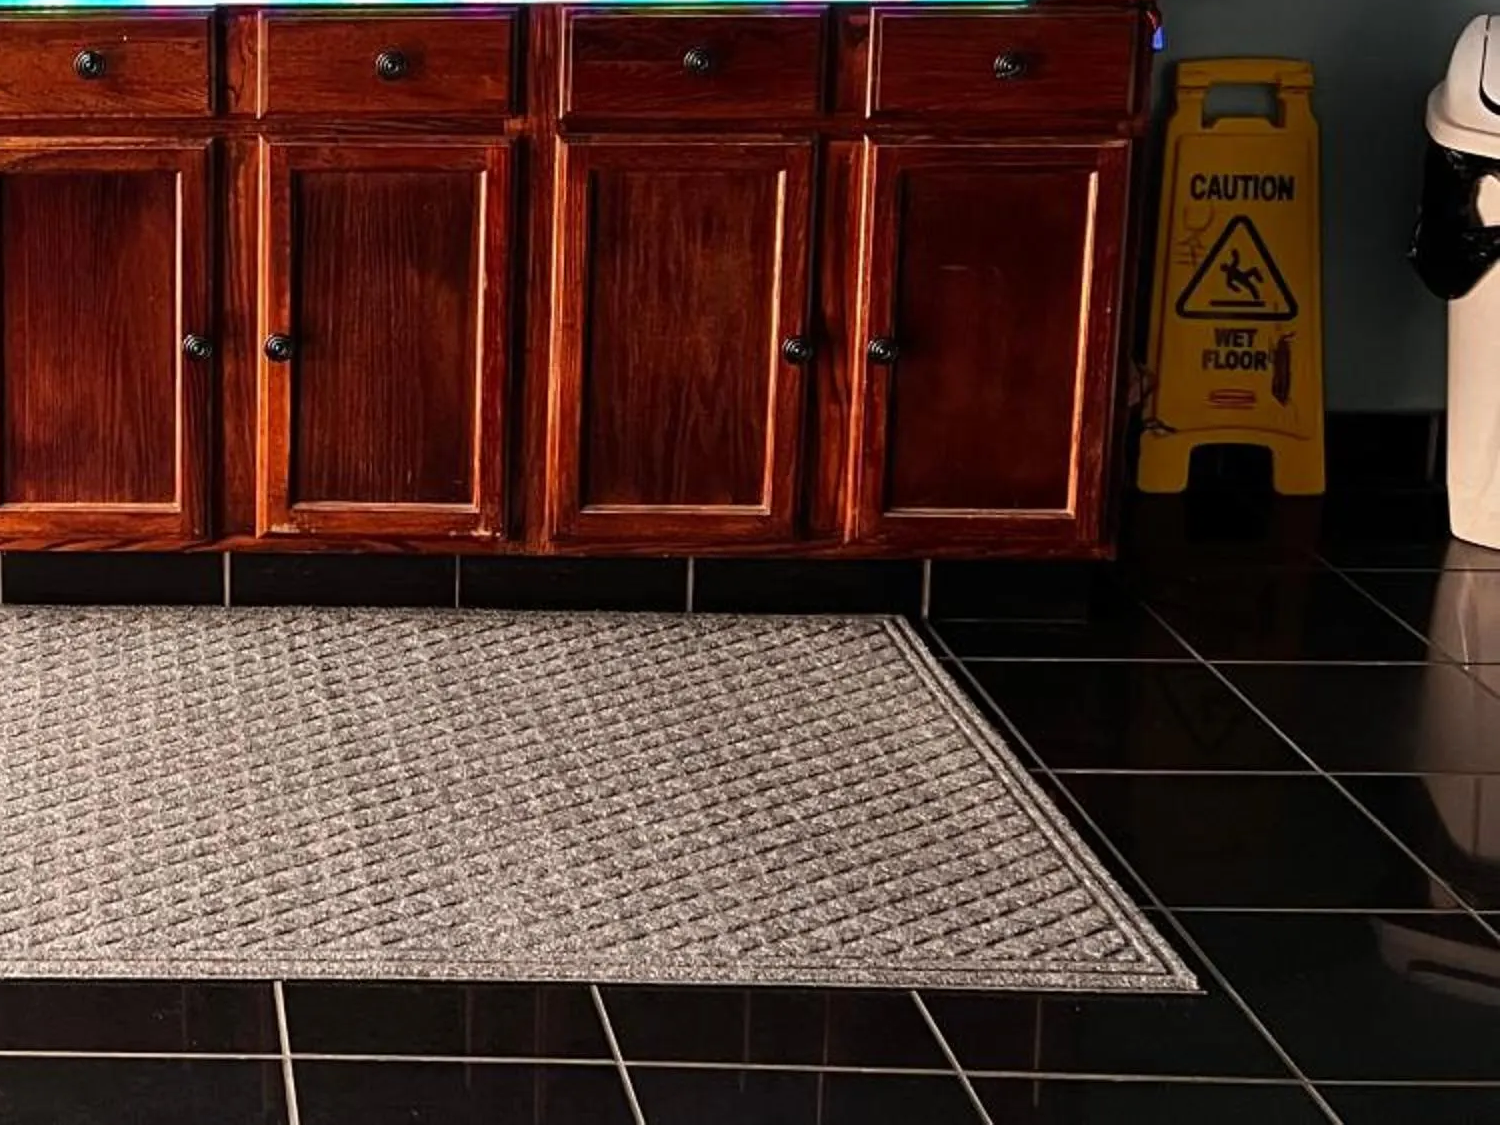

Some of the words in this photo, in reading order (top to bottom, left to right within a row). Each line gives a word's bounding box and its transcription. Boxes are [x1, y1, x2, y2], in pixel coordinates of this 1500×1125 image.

[1190, 174, 1295, 201] CAUTION
[1213, 328, 1258, 348] WET
[1202, 350, 1269, 371] FLOOR
